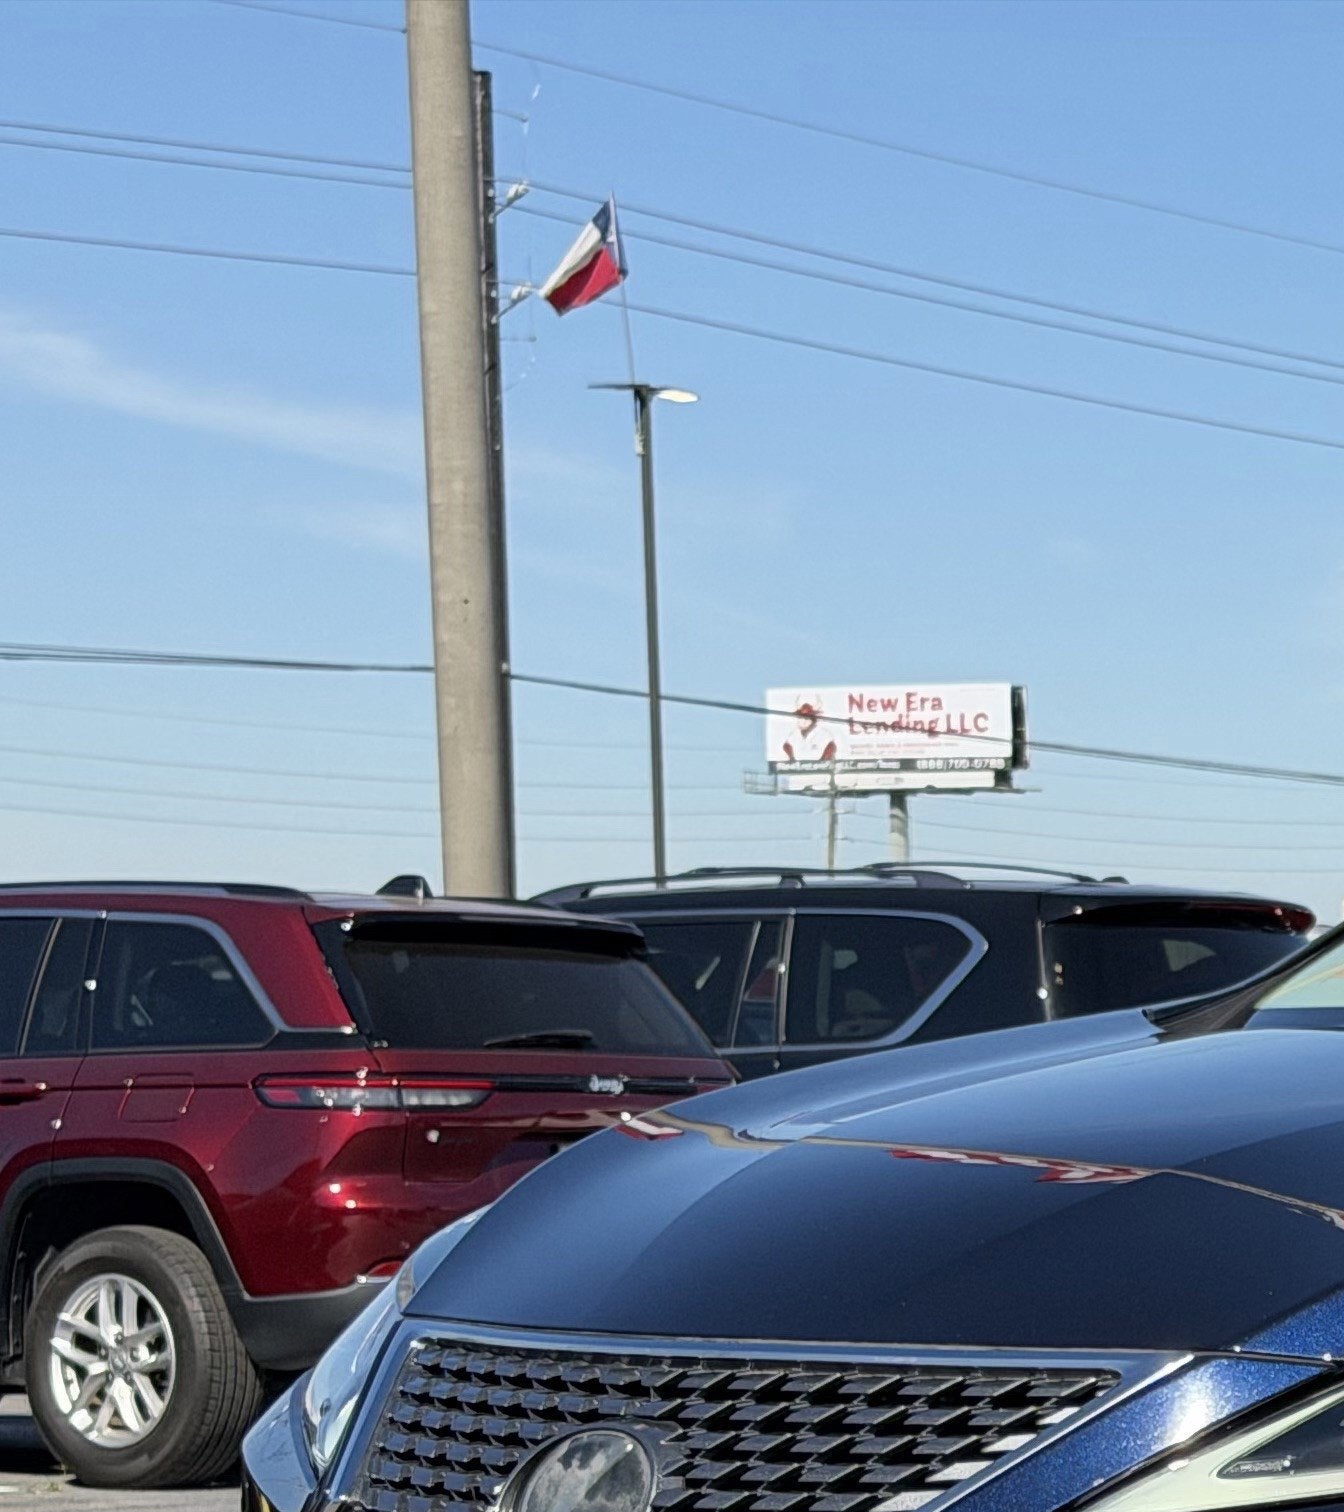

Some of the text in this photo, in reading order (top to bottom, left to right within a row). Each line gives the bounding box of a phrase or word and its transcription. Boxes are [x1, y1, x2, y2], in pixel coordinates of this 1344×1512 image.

[848, 691, 944, 713] New Era
[848, 712, 989, 738] Lending LLC
